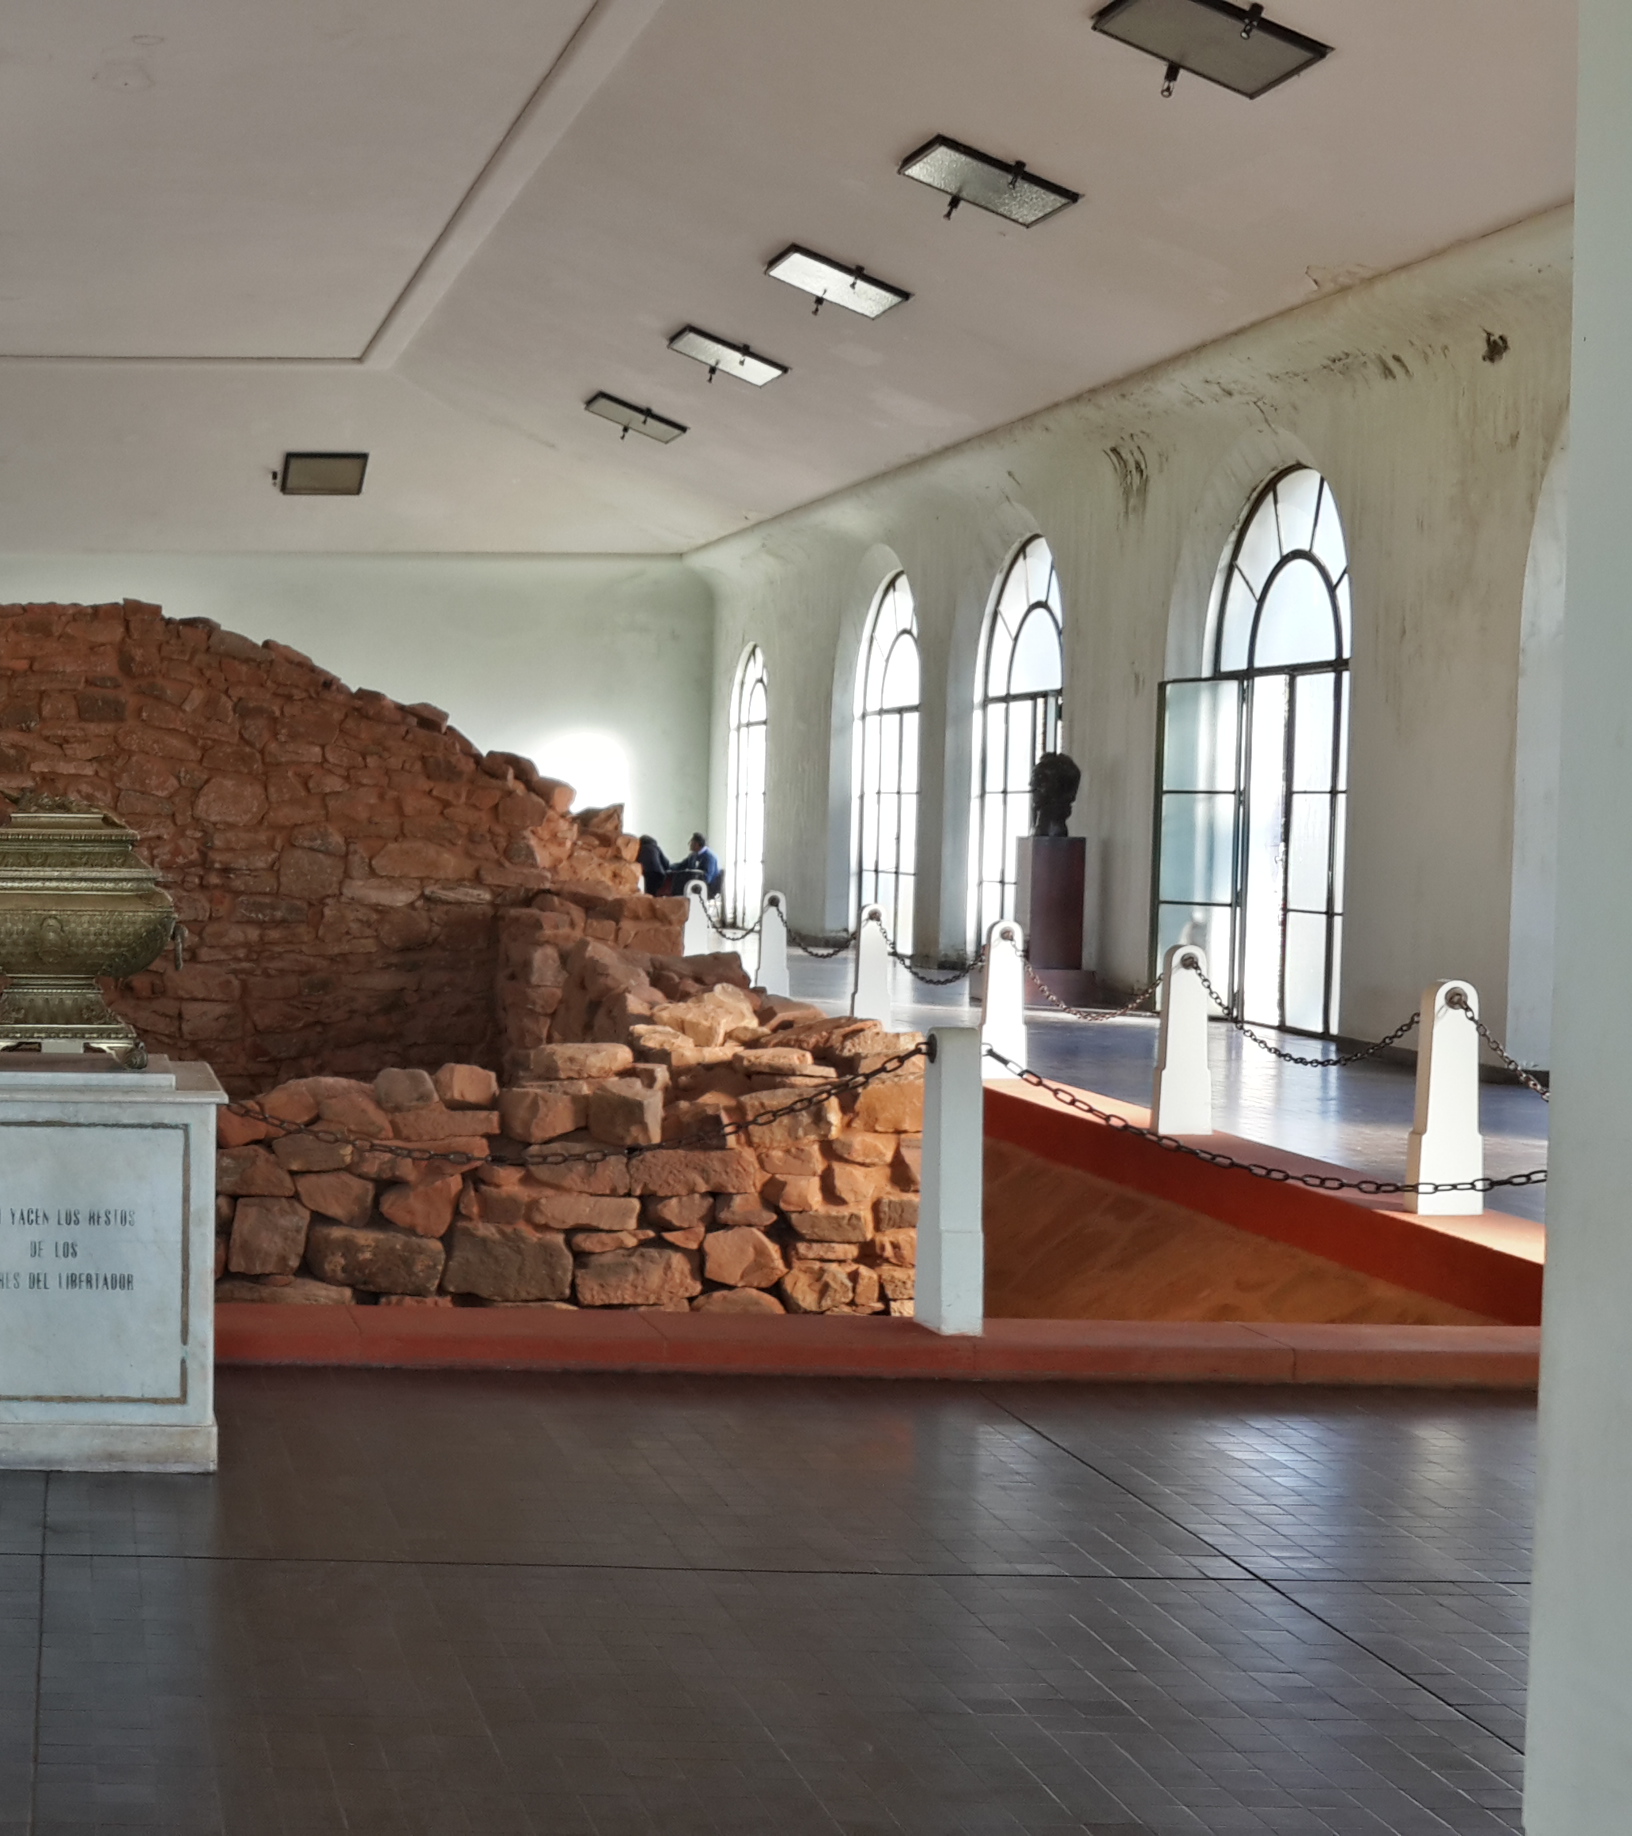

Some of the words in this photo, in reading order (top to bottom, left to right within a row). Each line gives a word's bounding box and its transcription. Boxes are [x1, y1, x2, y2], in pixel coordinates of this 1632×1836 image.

[10, 1207, 49, 1226] YACEN
[57, 1208, 80, 1226] LOS
[88, 1208, 135, 1227] RESTOS
[29, 1240, 44, 1258] DE
[54, 1241, 78, 1258] LOS
[28, 1272, 50, 1290] DEL
[58, 1272, 134, 1291] LIBERTADOR
